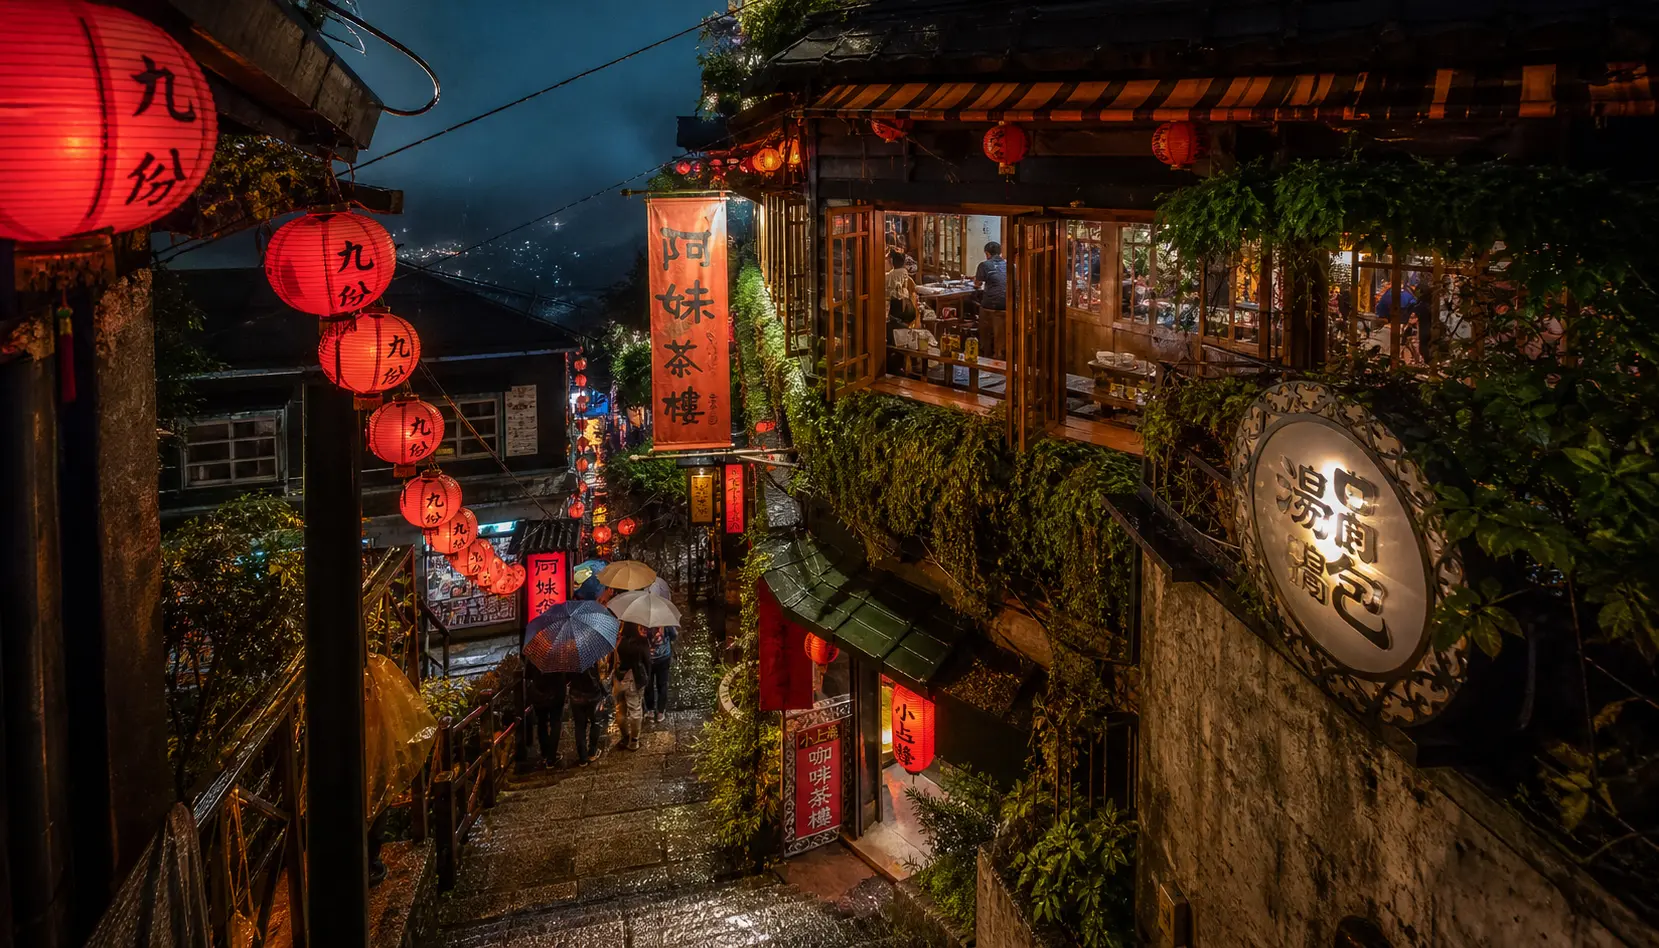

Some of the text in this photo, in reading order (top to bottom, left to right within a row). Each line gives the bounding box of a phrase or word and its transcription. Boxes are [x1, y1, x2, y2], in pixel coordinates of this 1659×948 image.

[125, 54, 196, 207] 九份
[336, 240, 374, 309] 九份
[381, 335, 411, 386] 九份
[655, 226, 717, 426] 阿妹茶樓
[408, 416, 432, 458] 九份
[425, 491, 445, 525] 九份
[807, 745, 832, 830] 咖啡茶樓
